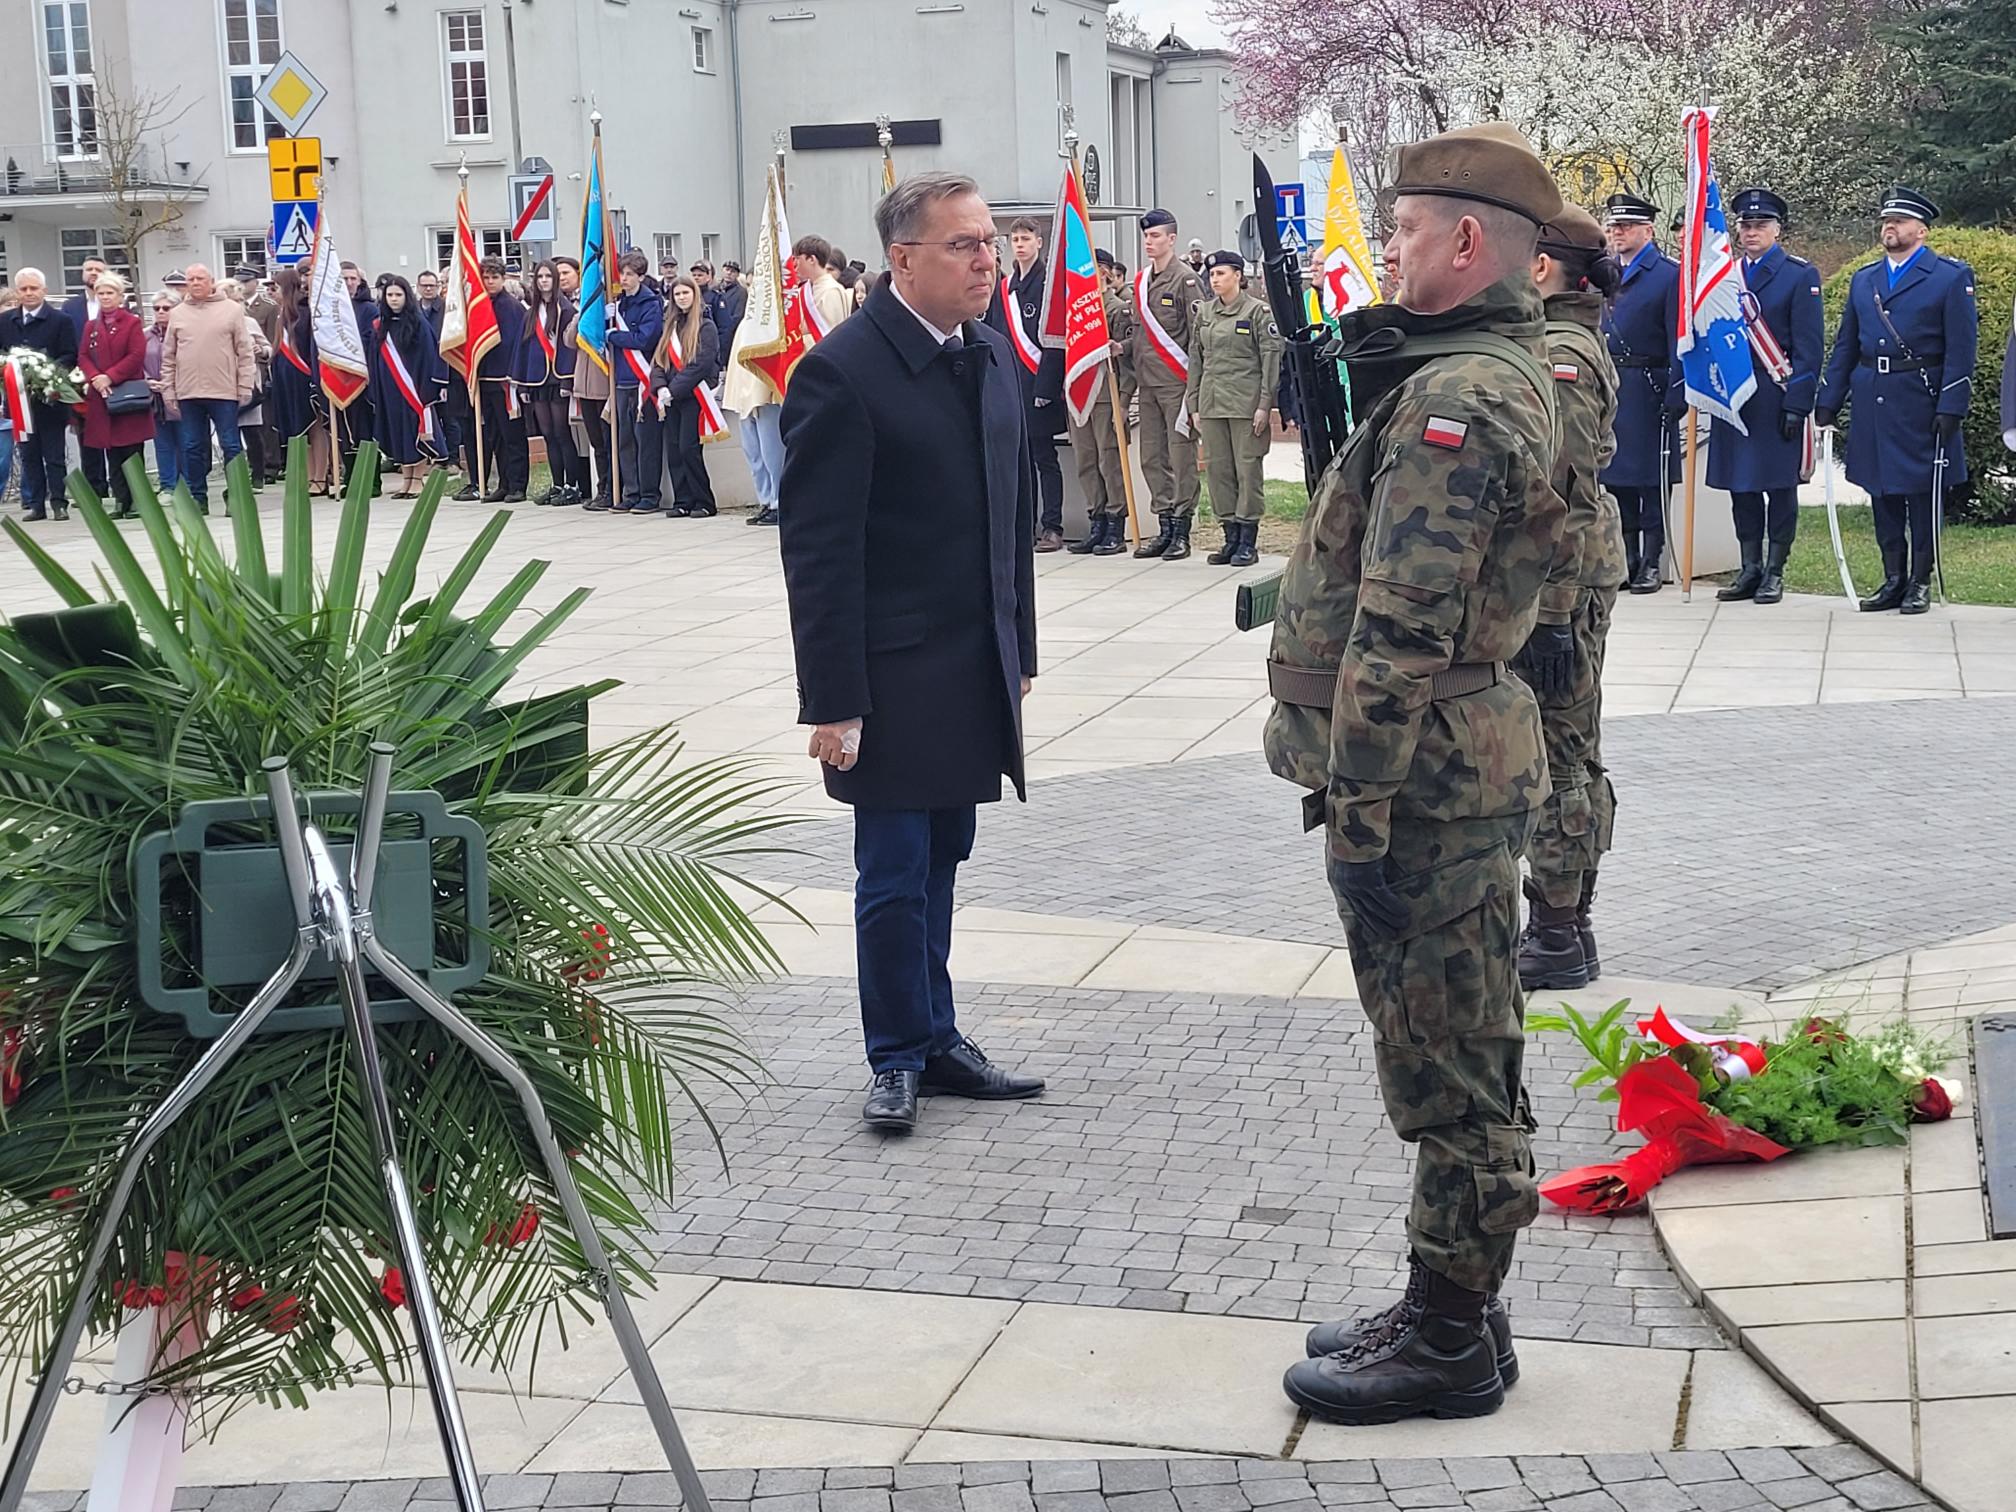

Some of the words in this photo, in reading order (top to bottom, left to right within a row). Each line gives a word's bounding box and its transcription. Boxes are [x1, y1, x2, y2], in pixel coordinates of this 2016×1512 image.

[1073, 311, 1084, 323] W
[1084, 301, 1101, 316] PILE
[1069, 330, 1086, 347] ZAŁ.
